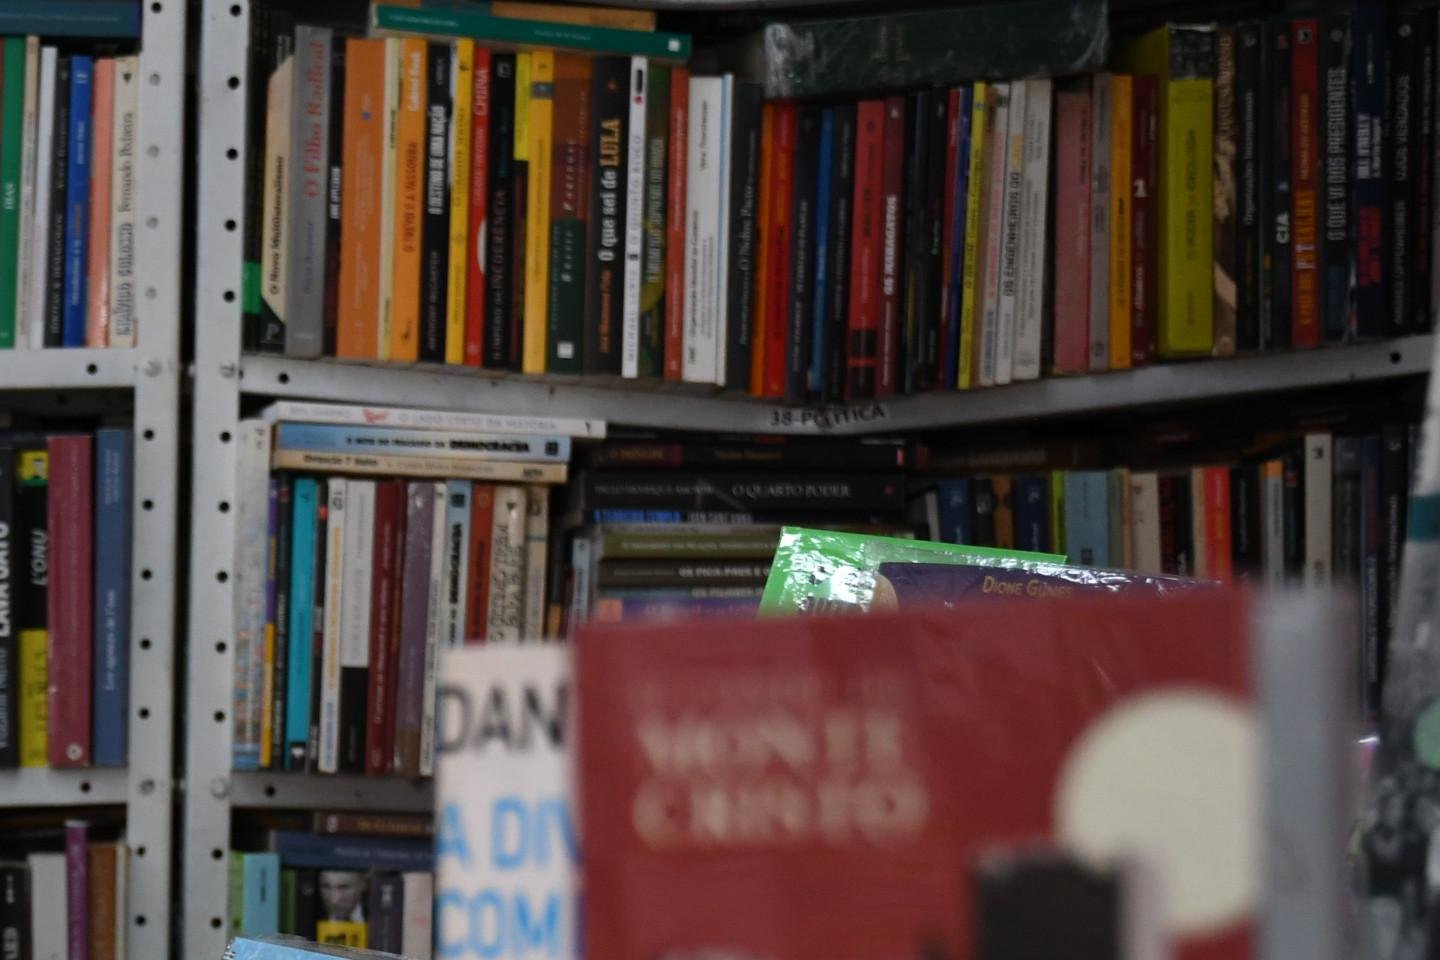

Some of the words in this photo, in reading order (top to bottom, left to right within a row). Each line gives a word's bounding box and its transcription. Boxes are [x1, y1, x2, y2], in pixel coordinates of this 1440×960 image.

[473, 66, 490, 116] CHINA
[1328, 66, 1347, 155] PRESIDENTES
[303, 123, 322, 174] Filho
[430, 136, 446, 157] UMA
[598, 118, 621, 168] LULA
[429, 158, 444, 169] DE
[1328, 156, 1347, 184] DOS
[427, 171, 445, 206] DESTINO
[599, 170, 619, 190] de
[600, 191, 617, 216] sei
[1327, 203, 1347, 229] QUE
[600, 217, 618, 247] que
[1276, 211, 1290, 244] CIA
[597, 249, 616, 261] O
[436, 684, 570, 756] DAN
